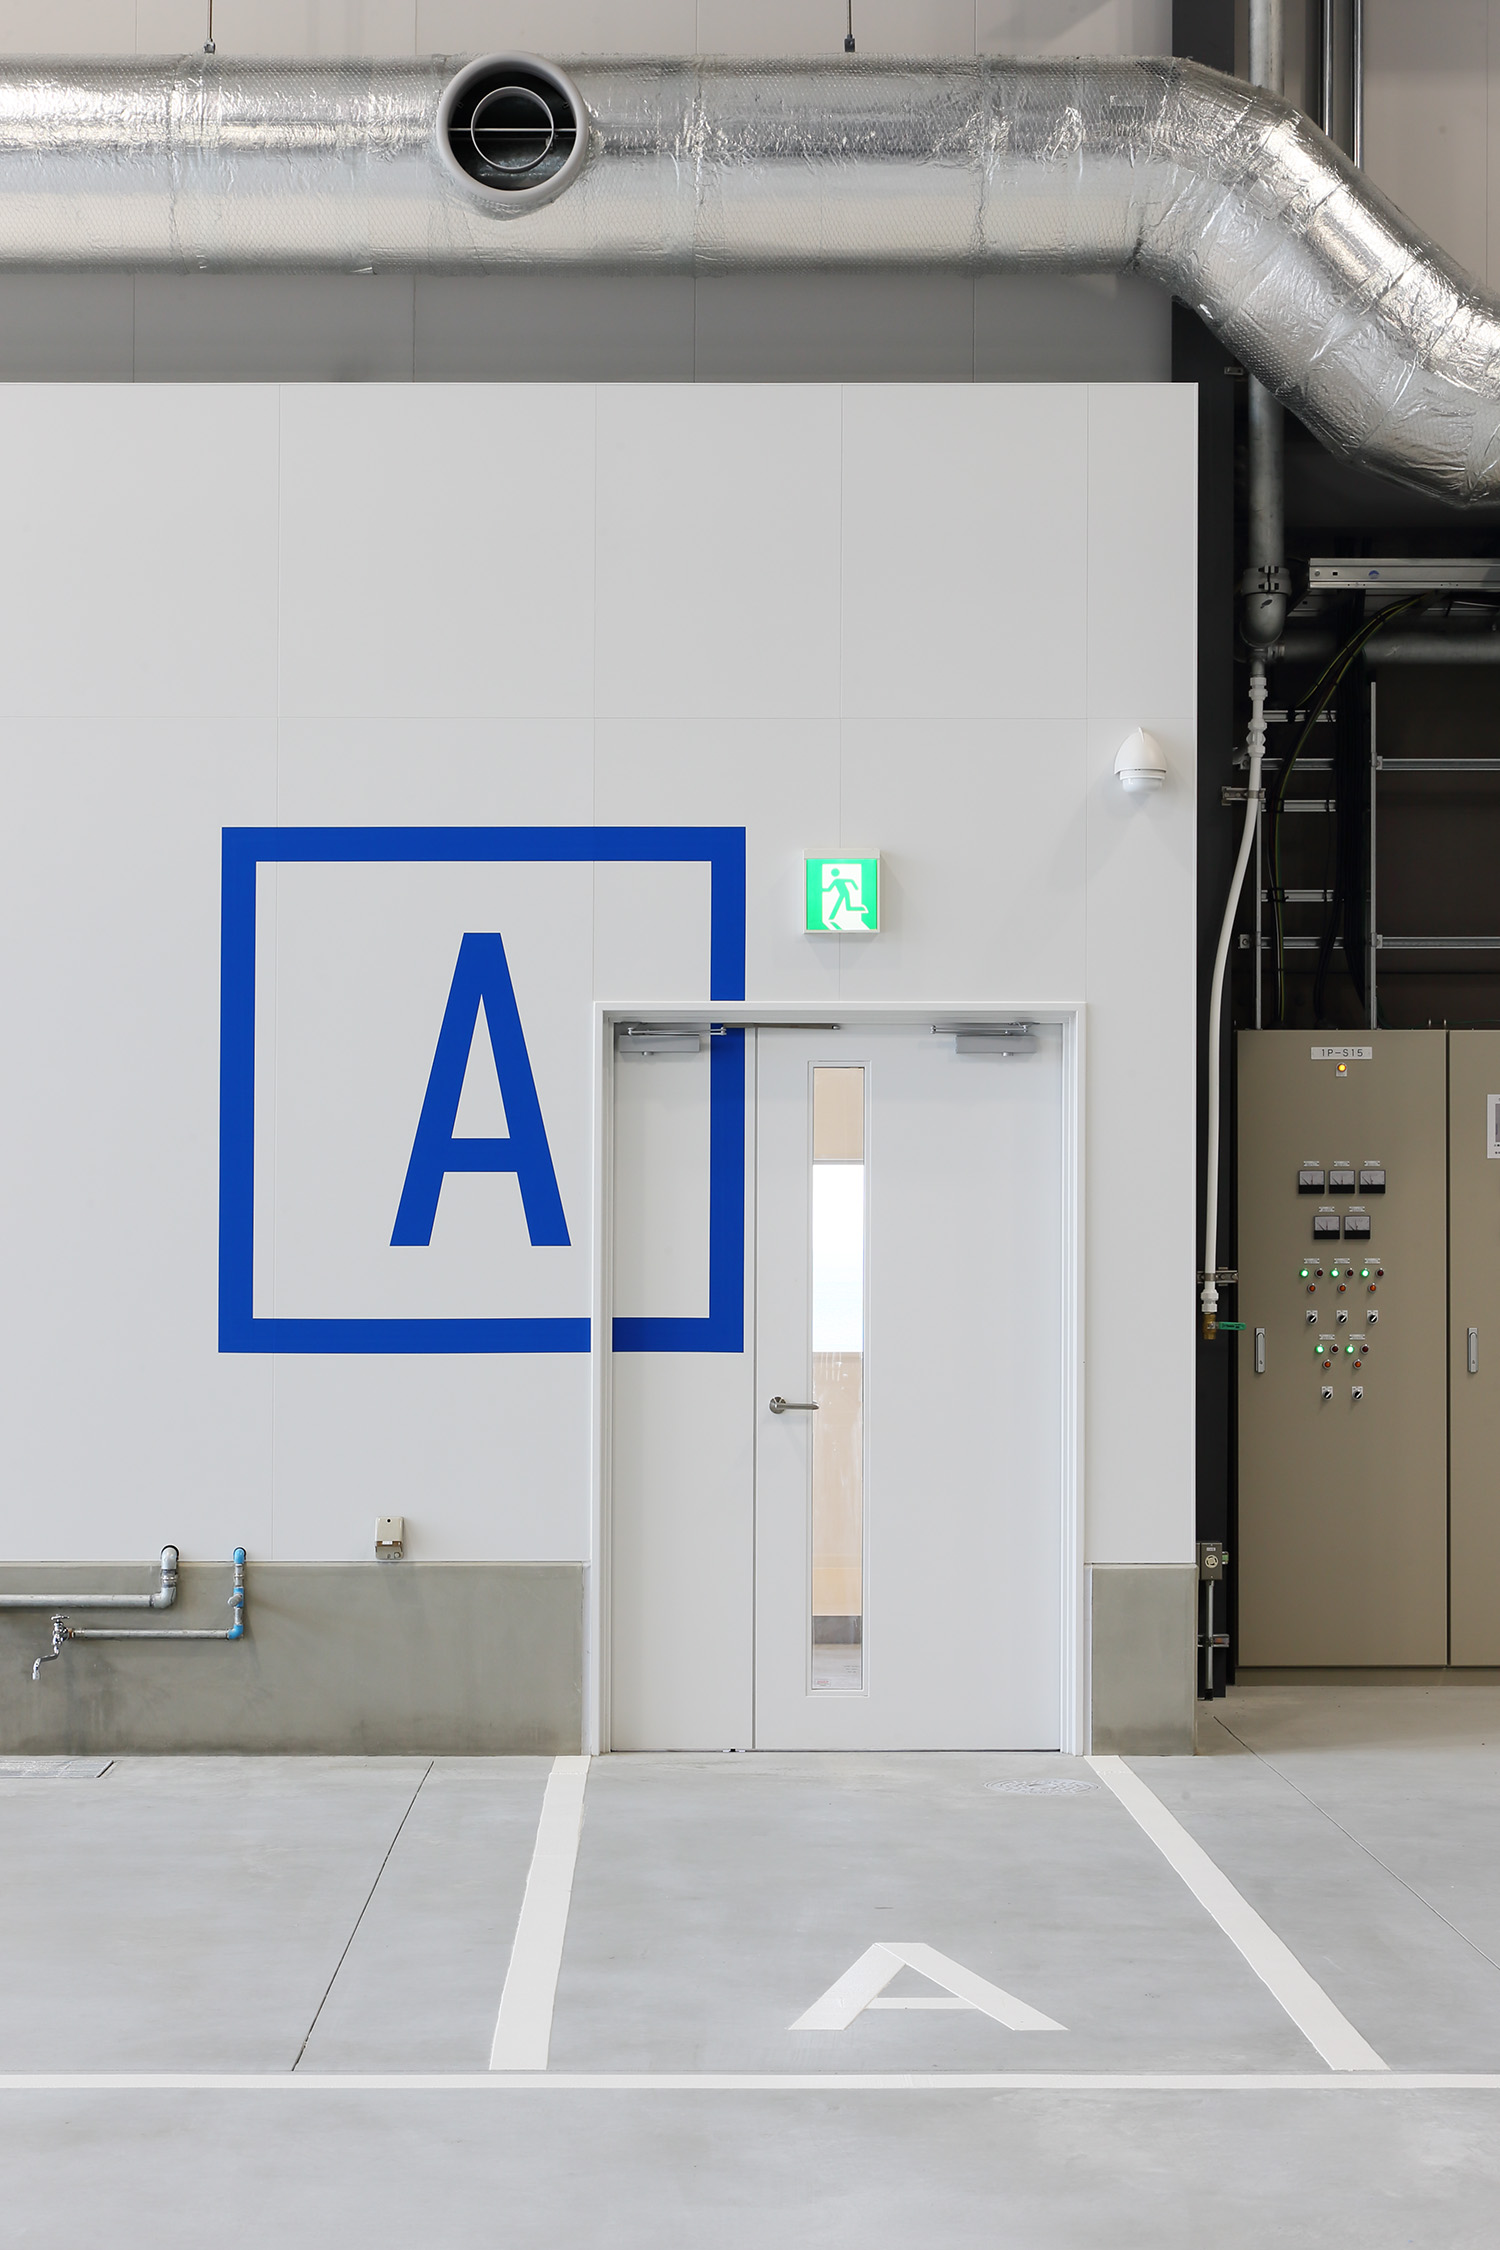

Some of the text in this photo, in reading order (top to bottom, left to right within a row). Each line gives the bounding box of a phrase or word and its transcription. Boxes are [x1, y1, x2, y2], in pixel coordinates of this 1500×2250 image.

[389, 932, 572, 1247] A
[1321, 1048, 1364, 1058] 1P-S15
[787, 1942, 1070, 2032] A
